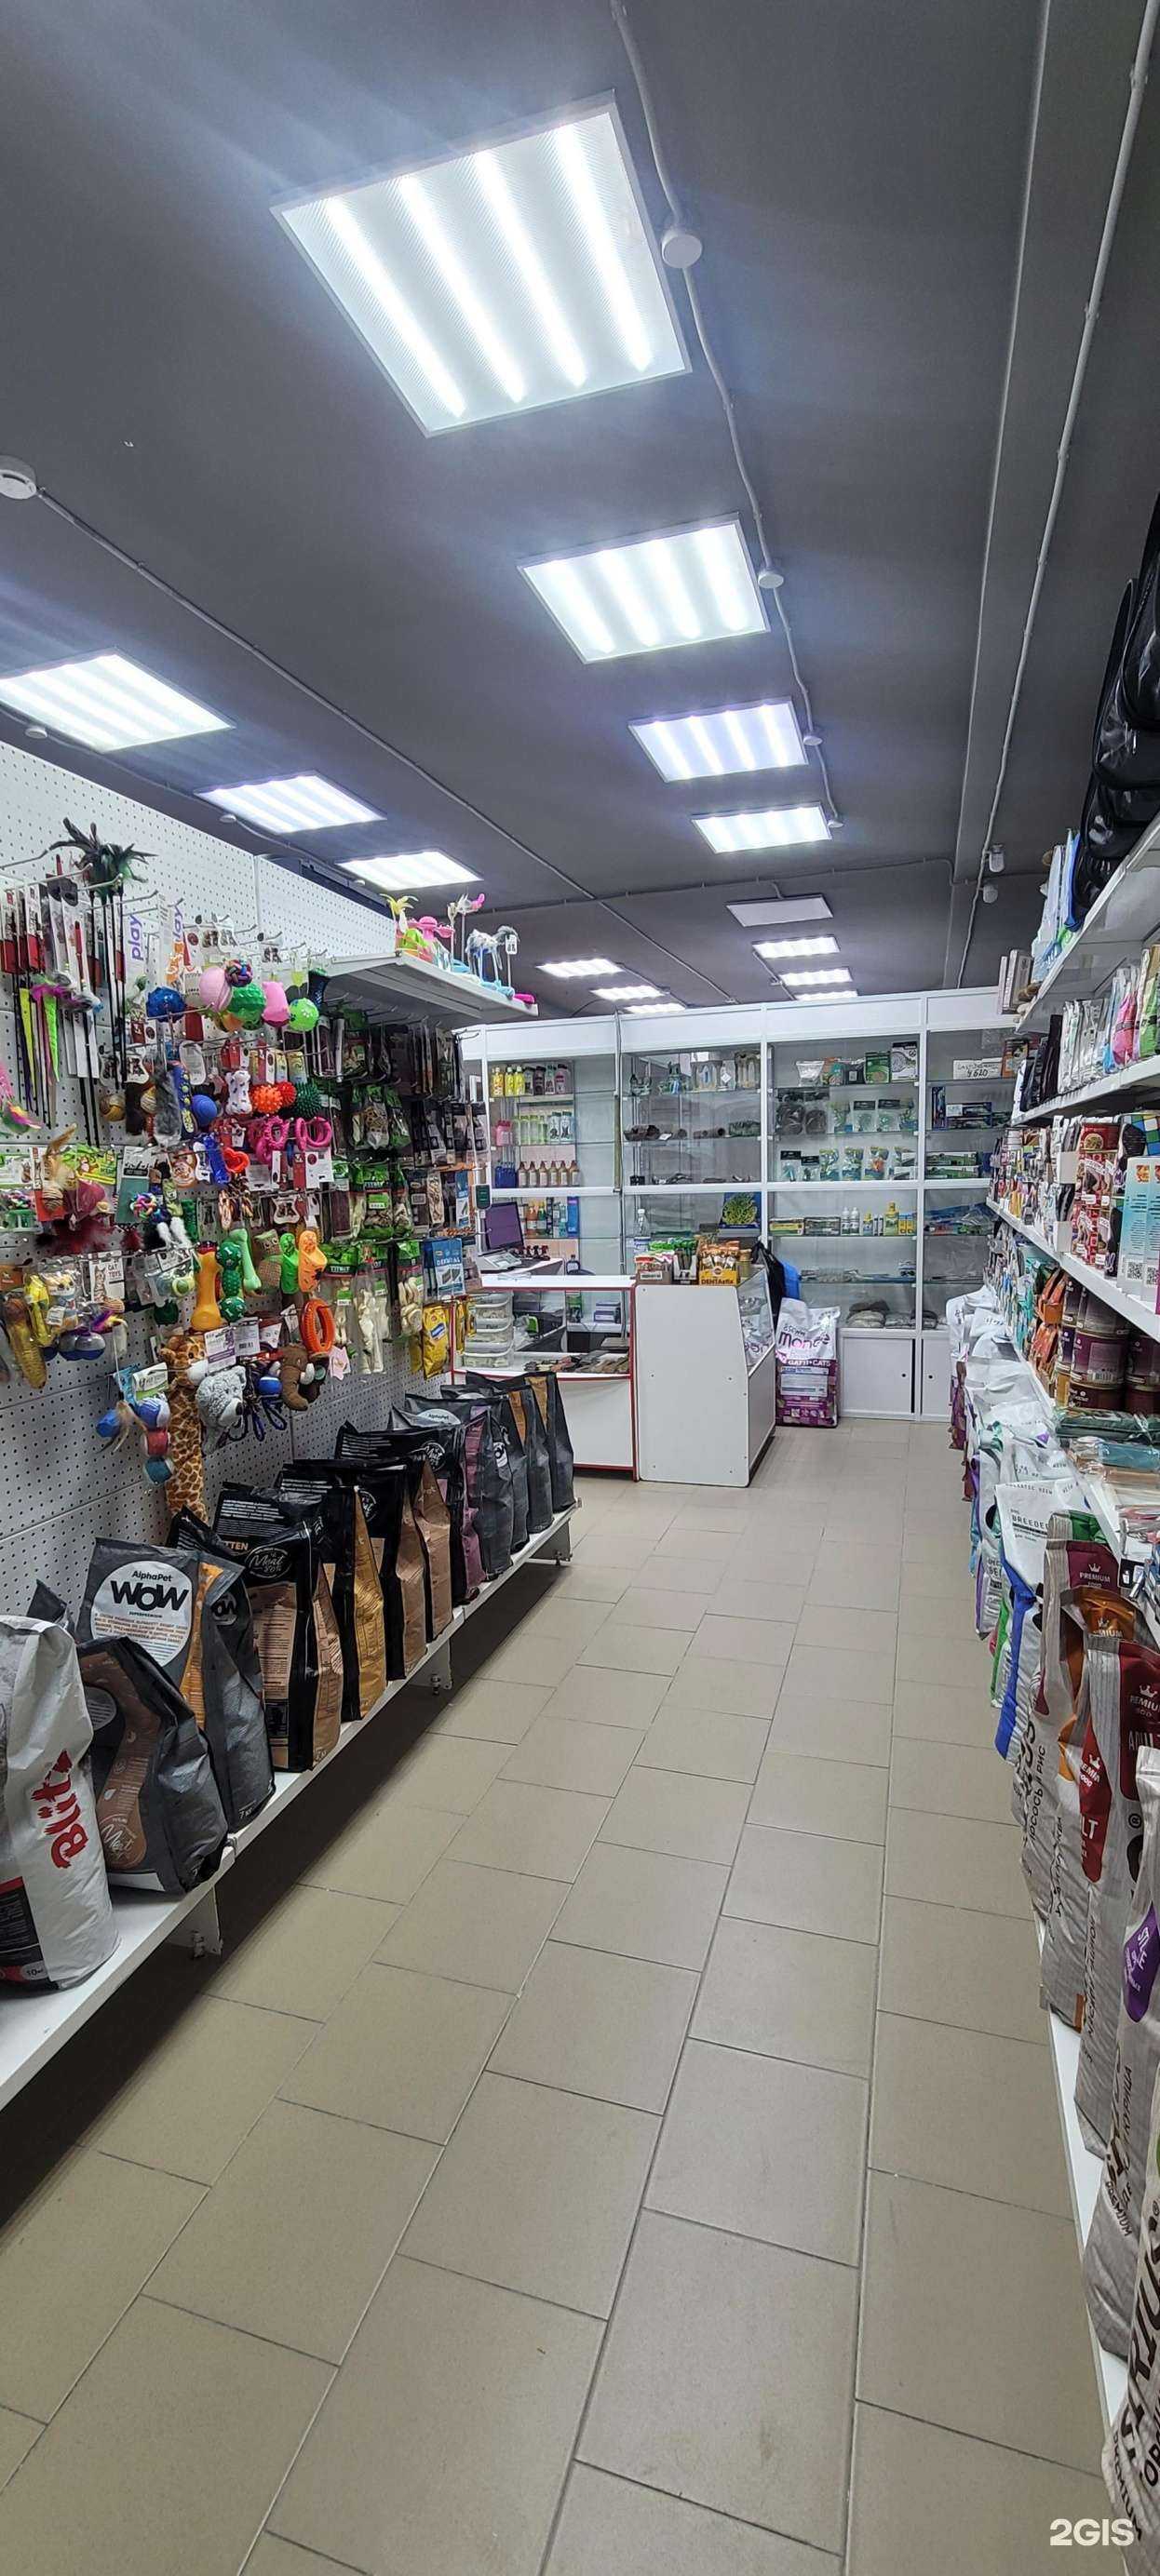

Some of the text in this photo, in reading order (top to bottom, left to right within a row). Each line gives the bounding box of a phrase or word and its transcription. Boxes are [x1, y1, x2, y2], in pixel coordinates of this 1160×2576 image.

[128, 914, 144, 960] play
[131, 1570, 172, 1582] AlphaPet
[1080, 1571, 1111, 1582] PREMIUM
[1123, 2065, 1133, 2133] КУРИЦА
[1105, 2180, 1133, 2236] PREMIUM
